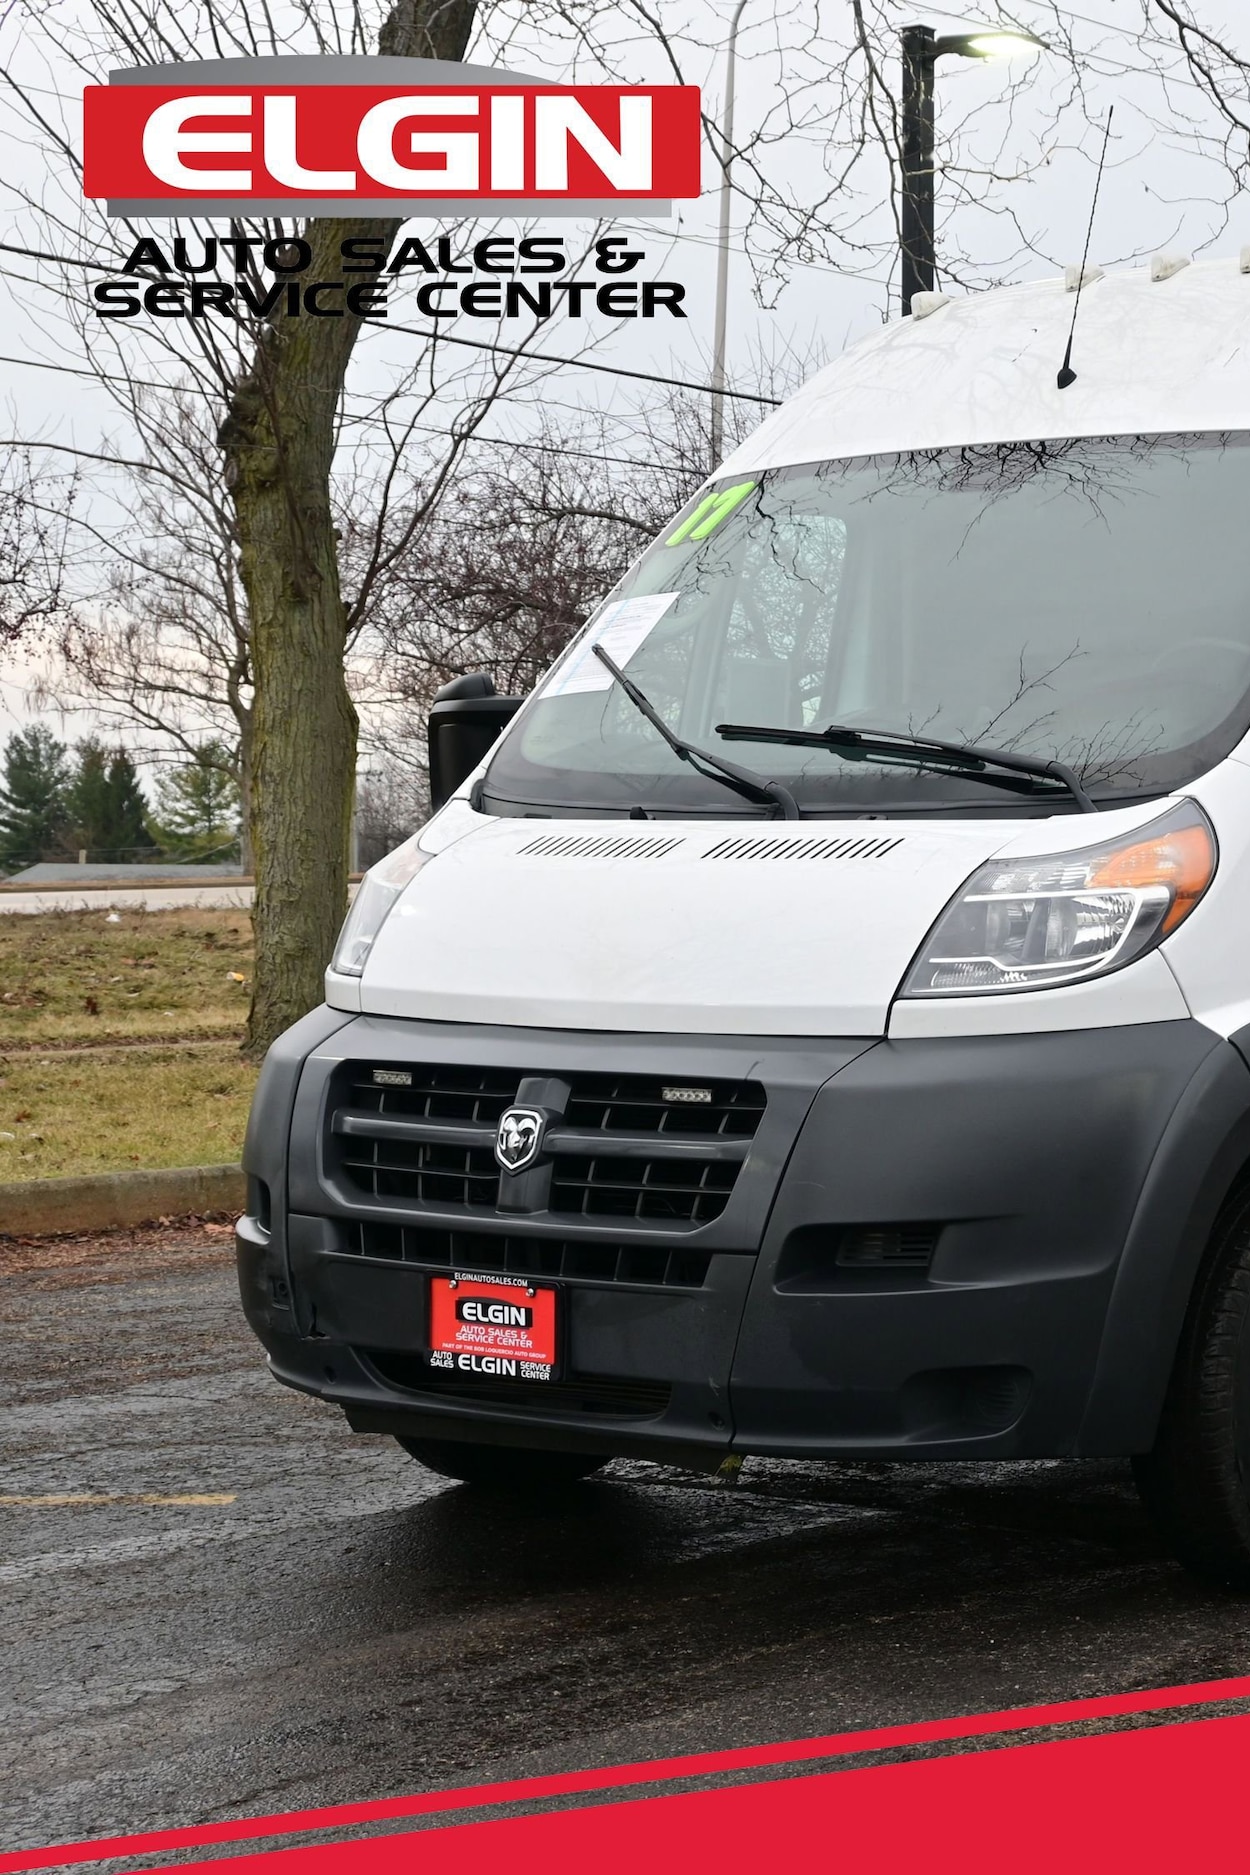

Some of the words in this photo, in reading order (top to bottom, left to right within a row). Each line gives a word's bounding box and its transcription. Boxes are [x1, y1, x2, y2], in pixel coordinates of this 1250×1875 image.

[454, 1272, 528, 1287] ELGINAUTOSALES.COM
[462, 1302, 526, 1326] ELGIN
[455, 1332, 494, 1344] SERVICE
[496, 1337, 533, 1348] CENTER
[460, 1325, 486, 1335] AUTO
[488, 1327, 517, 1339] SALES
[520, 1331, 527, 1340] &
[432, 1350, 453, 1360] AUTO
[430, 1358, 454, 1369] SALES
[458, 1353, 517, 1377] ELGIN
[520, 1360, 551, 1373] SERVICE
[521, 1369, 550, 1381] CENTER
